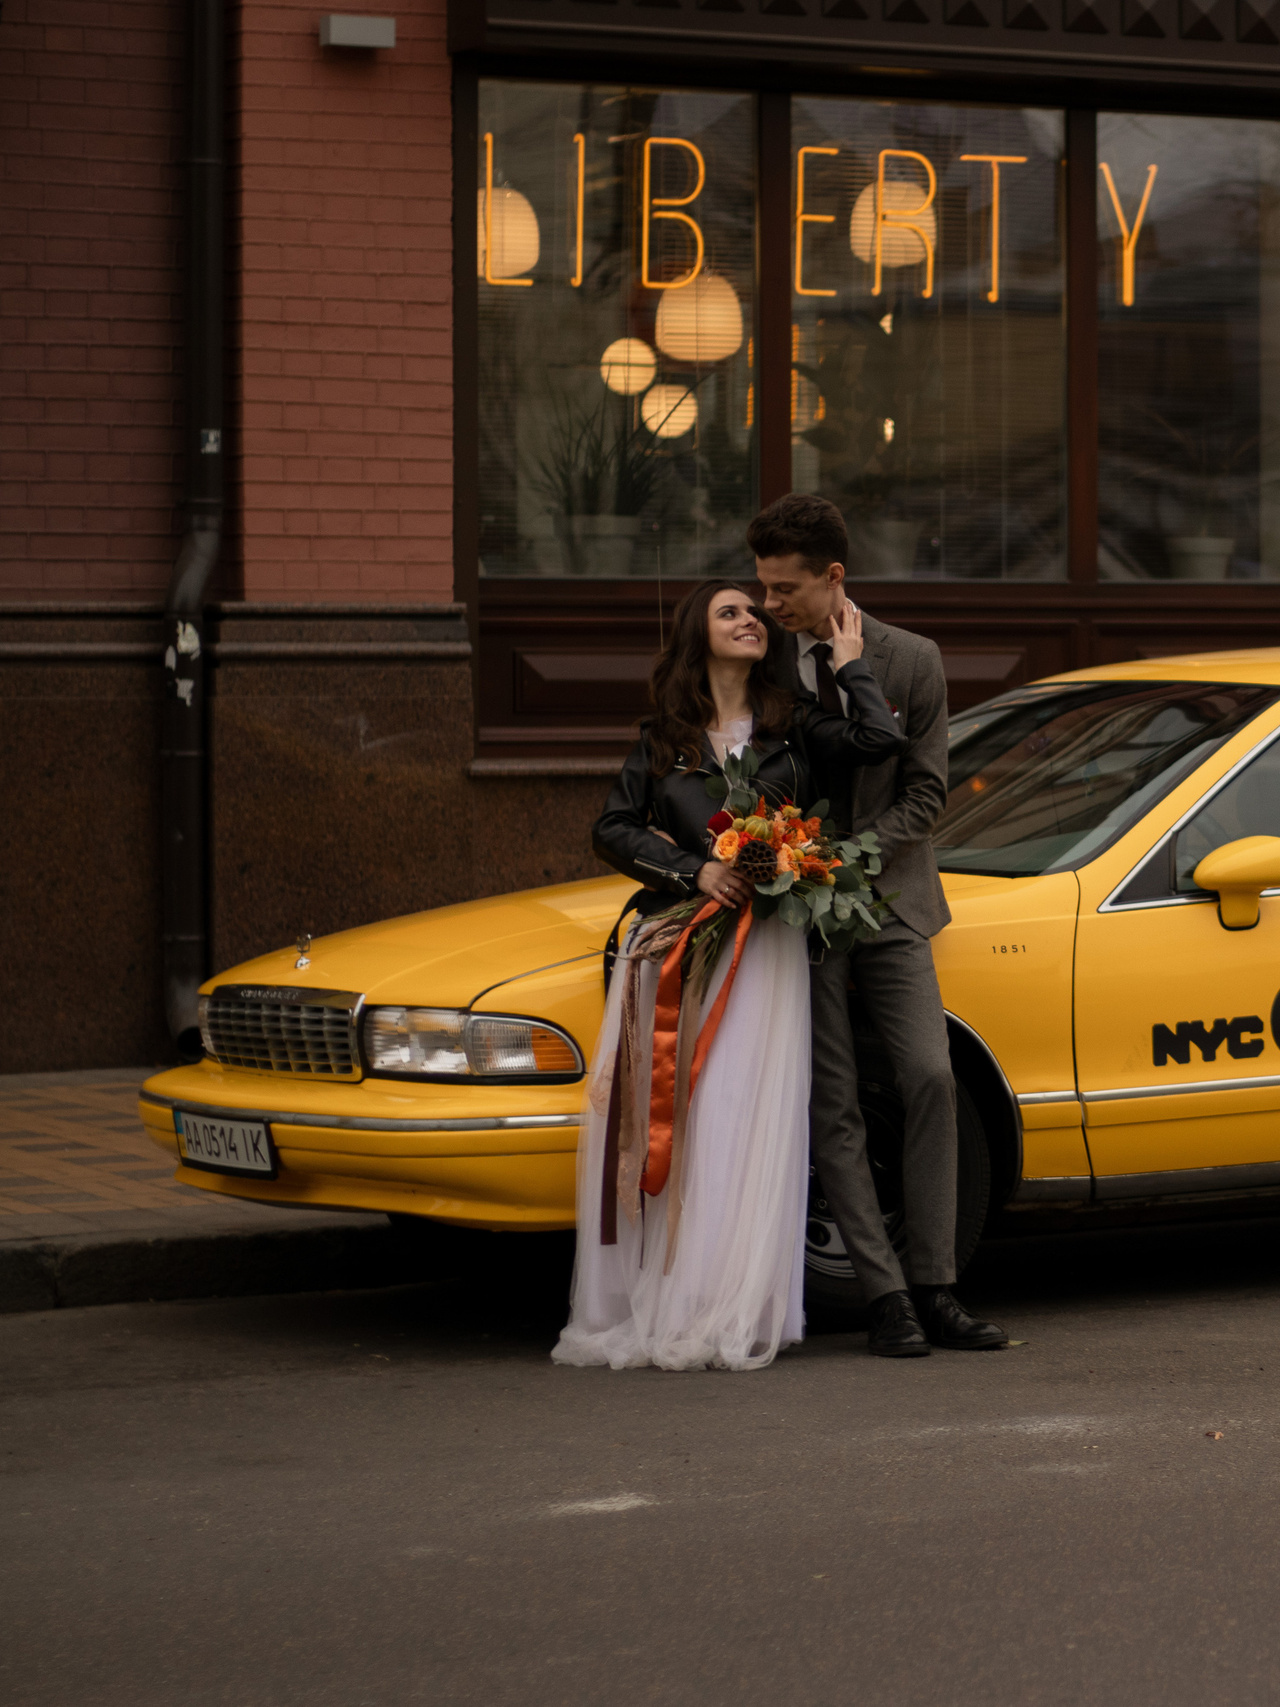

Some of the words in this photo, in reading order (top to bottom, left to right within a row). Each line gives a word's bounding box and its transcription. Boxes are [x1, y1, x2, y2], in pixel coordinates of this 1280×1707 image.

[483, 131, 1159, 307] LIBERTY
[992, 944, 1026, 954] 1851
[1153, 1014, 1264, 1067] NYC
